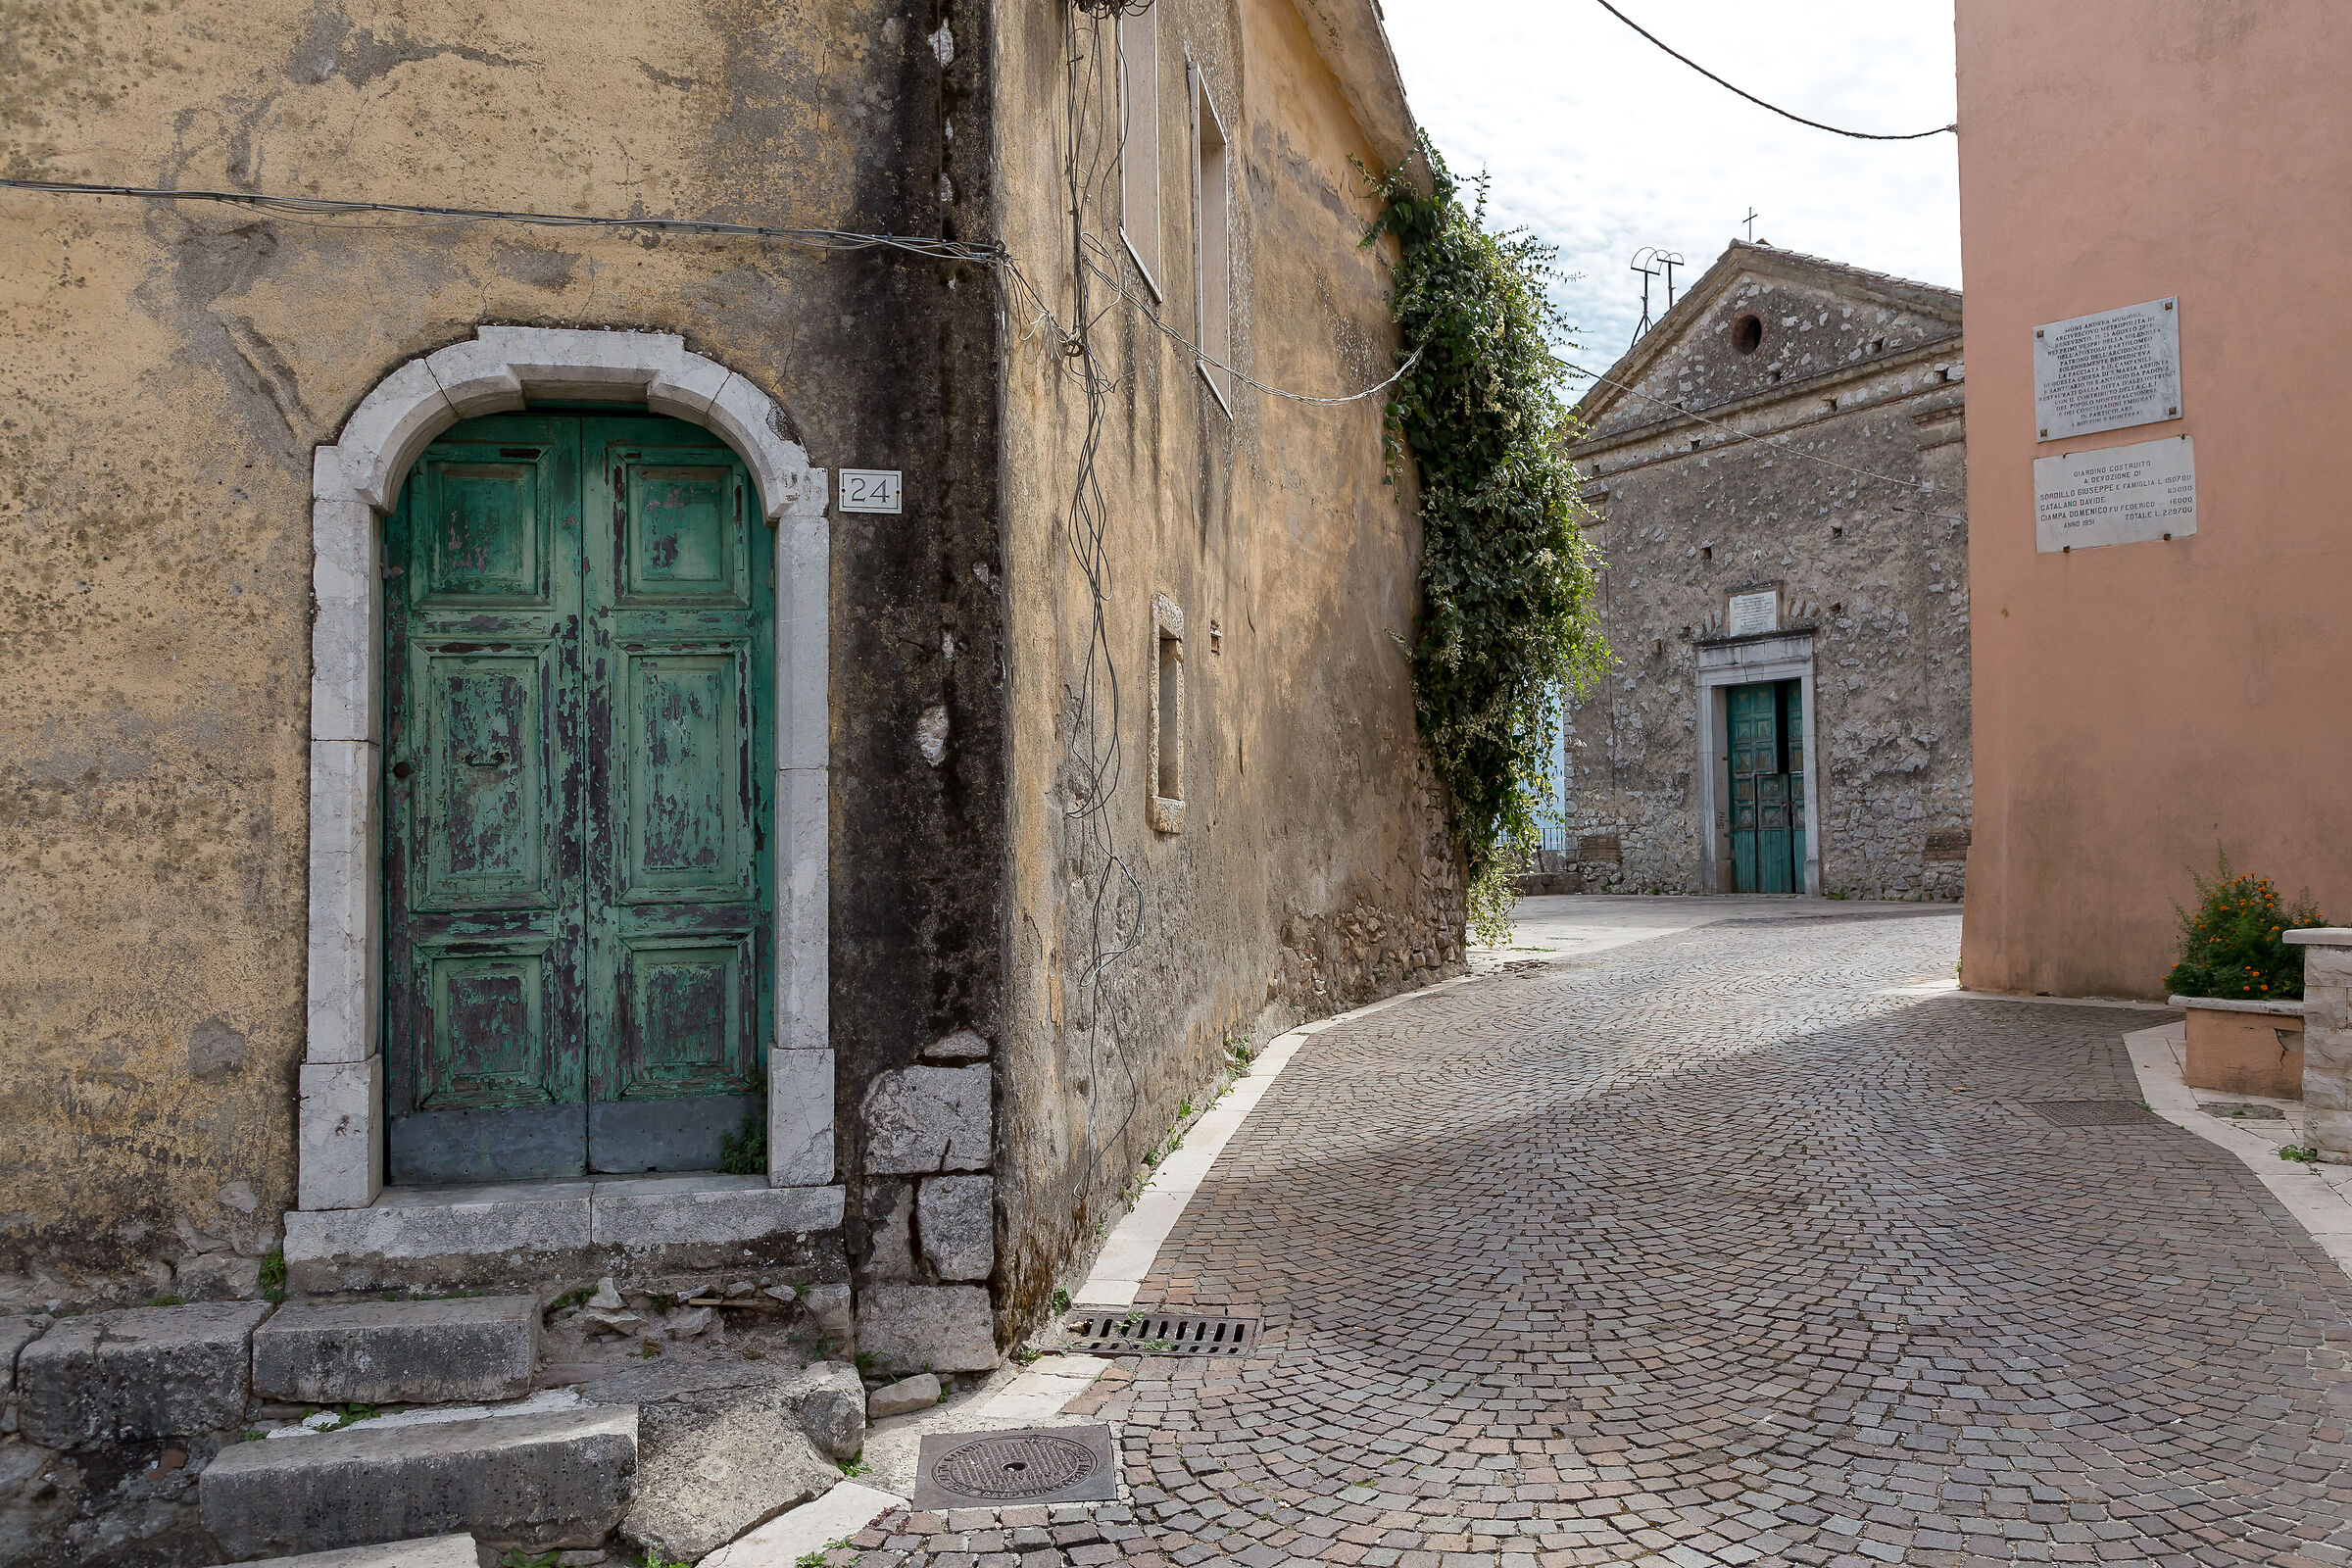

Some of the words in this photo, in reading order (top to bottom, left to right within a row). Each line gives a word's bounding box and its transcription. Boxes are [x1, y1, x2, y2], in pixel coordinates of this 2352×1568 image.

[2056, 328, 2099, 341] ARCIVESCOVO
[2101, 318, 2145, 332] METROPOLITA
[2084, 319, 2109, 328] ANDREA
[2112, 326, 2136, 336] AGOSTO
[2079, 341, 2100, 350] VESPRI
[2109, 336, 2152, 350] BARTOLOMEO
[2059, 359, 2108, 372] SOLENNEMENTE
[2110, 350, 2150, 363] BENEDICEVA
[2060, 357, 2088, 367] PATRONO
[2069, 368, 2099, 377] FACCIATA
[2049, 383, 2084, 393] SANTUARIO
[2101, 373, 2130, 384] ANTONIO
[2051, 378, 2076, 387] QUESTA
[2077, 373, 2100, 382] CHIESA
[2038, 391, 2077, 402] RESTAURATI
[2077, 389, 2117, 401] CONTRIBUTO
[2070, 400, 2094, 409] POPOLO
[2077, 402, 2122, 414] CONCITTADINI
[2089, 406, 2132, 417] PARTICOLARE
[2074, 467, 2106, 478] GIARDINO
[2109, 461, 2151, 472] COSTRUITO
[2091, 472, 2131, 483] DEVOZIONE
[852, 477, 890, 503] 24
[2040, 490, 2075, 501] SORDILLO
[2078, 485, 2114, 496] GIUSEPPE
[2124, 480, 2155, 489] FAMIGLIA
[2040, 501, 2077, 512] CATALANO
[2080, 497, 2105, 506] DAVIDE
[2040, 513, 2067, 521] CIAMPA
[2070, 507, 2107, 517] DOMENICO
[2121, 502, 2155, 511] FEDERICO
[2126, 512, 2152, 520] TOTALE
[2163, 507, 2192, 516] 229700
